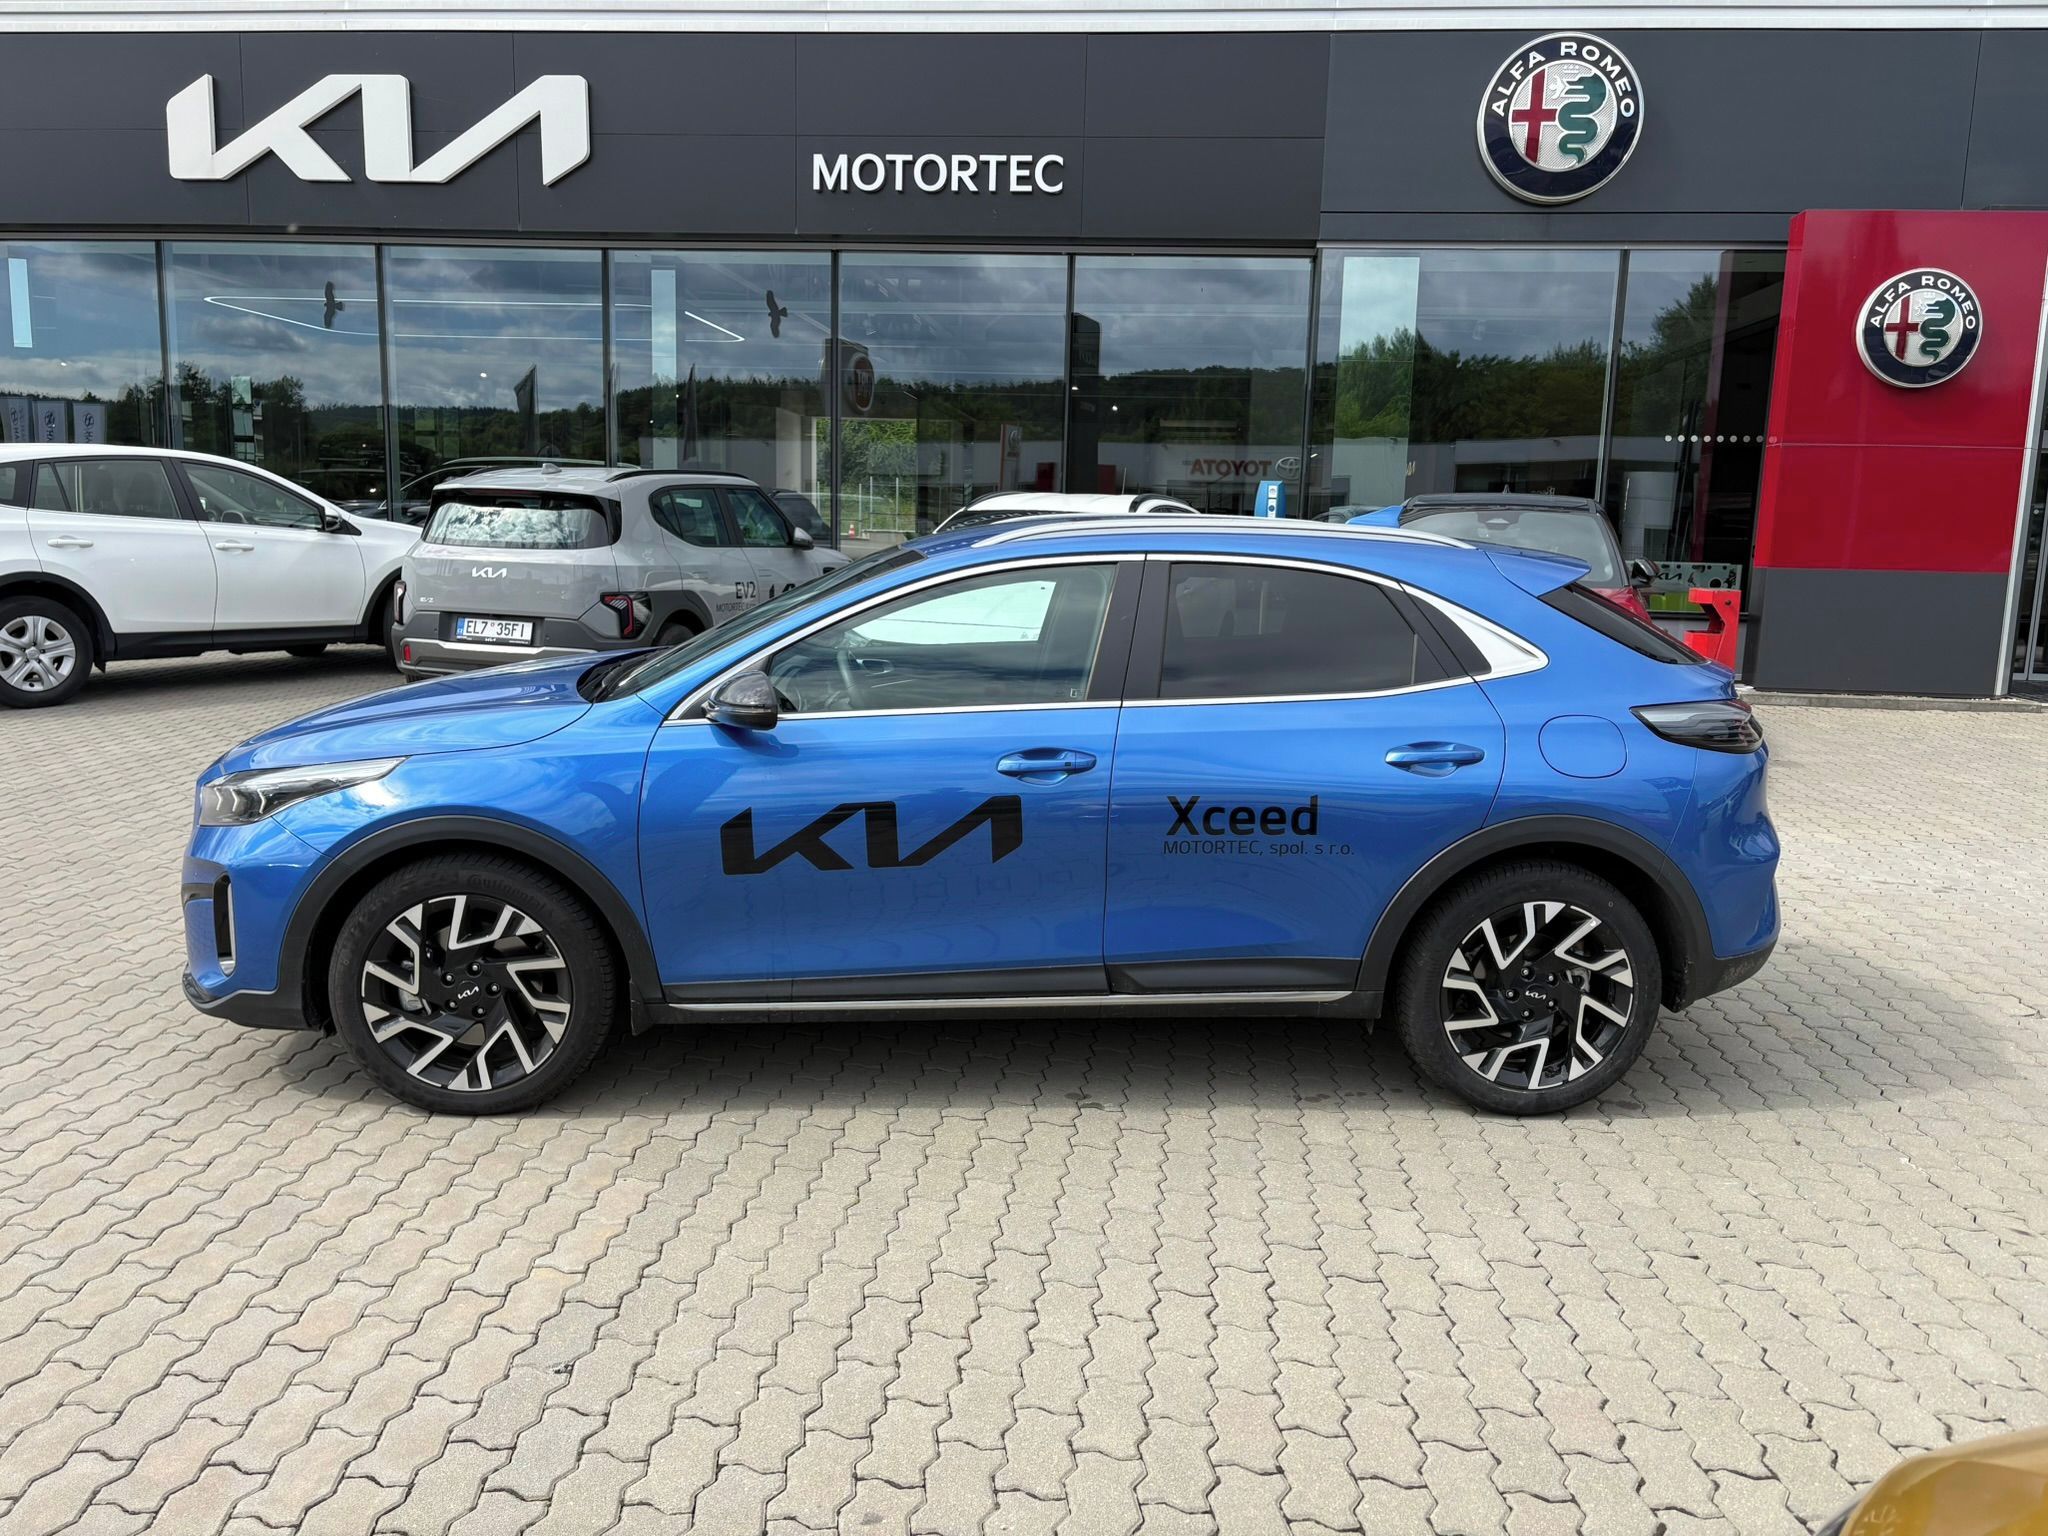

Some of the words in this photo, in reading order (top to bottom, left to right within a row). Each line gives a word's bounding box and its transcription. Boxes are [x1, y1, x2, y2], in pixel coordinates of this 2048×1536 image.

[1491, 50, 1546, 117] ALFA
[1560, 41, 1635, 117] ROMEO
[166, 73, 591, 187] KIA
[812, 153, 1064, 194] MOTORTEC
[1870, 281, 1911, 328] ALFA
[1921, 275, 1976, 329] ROMEO
[472, 566, 507, 579] KIA
[735, 581, 756, 599] EV2
[466, 620, 488, 635] EL7
[497, 622, 525, 638] 35FI
[720, 795, 1023, 875] KIA
[1166, 794, 1319, 836] Xceed
[1163, 840, 1264, 856] MOTORTEC,
[1269, 841, 1308, 857] spol.
[1314, 844, 1323, 855] s
[1329, 844, 1355, 855] r.o.
[457, 986, 479, 999] KIA
